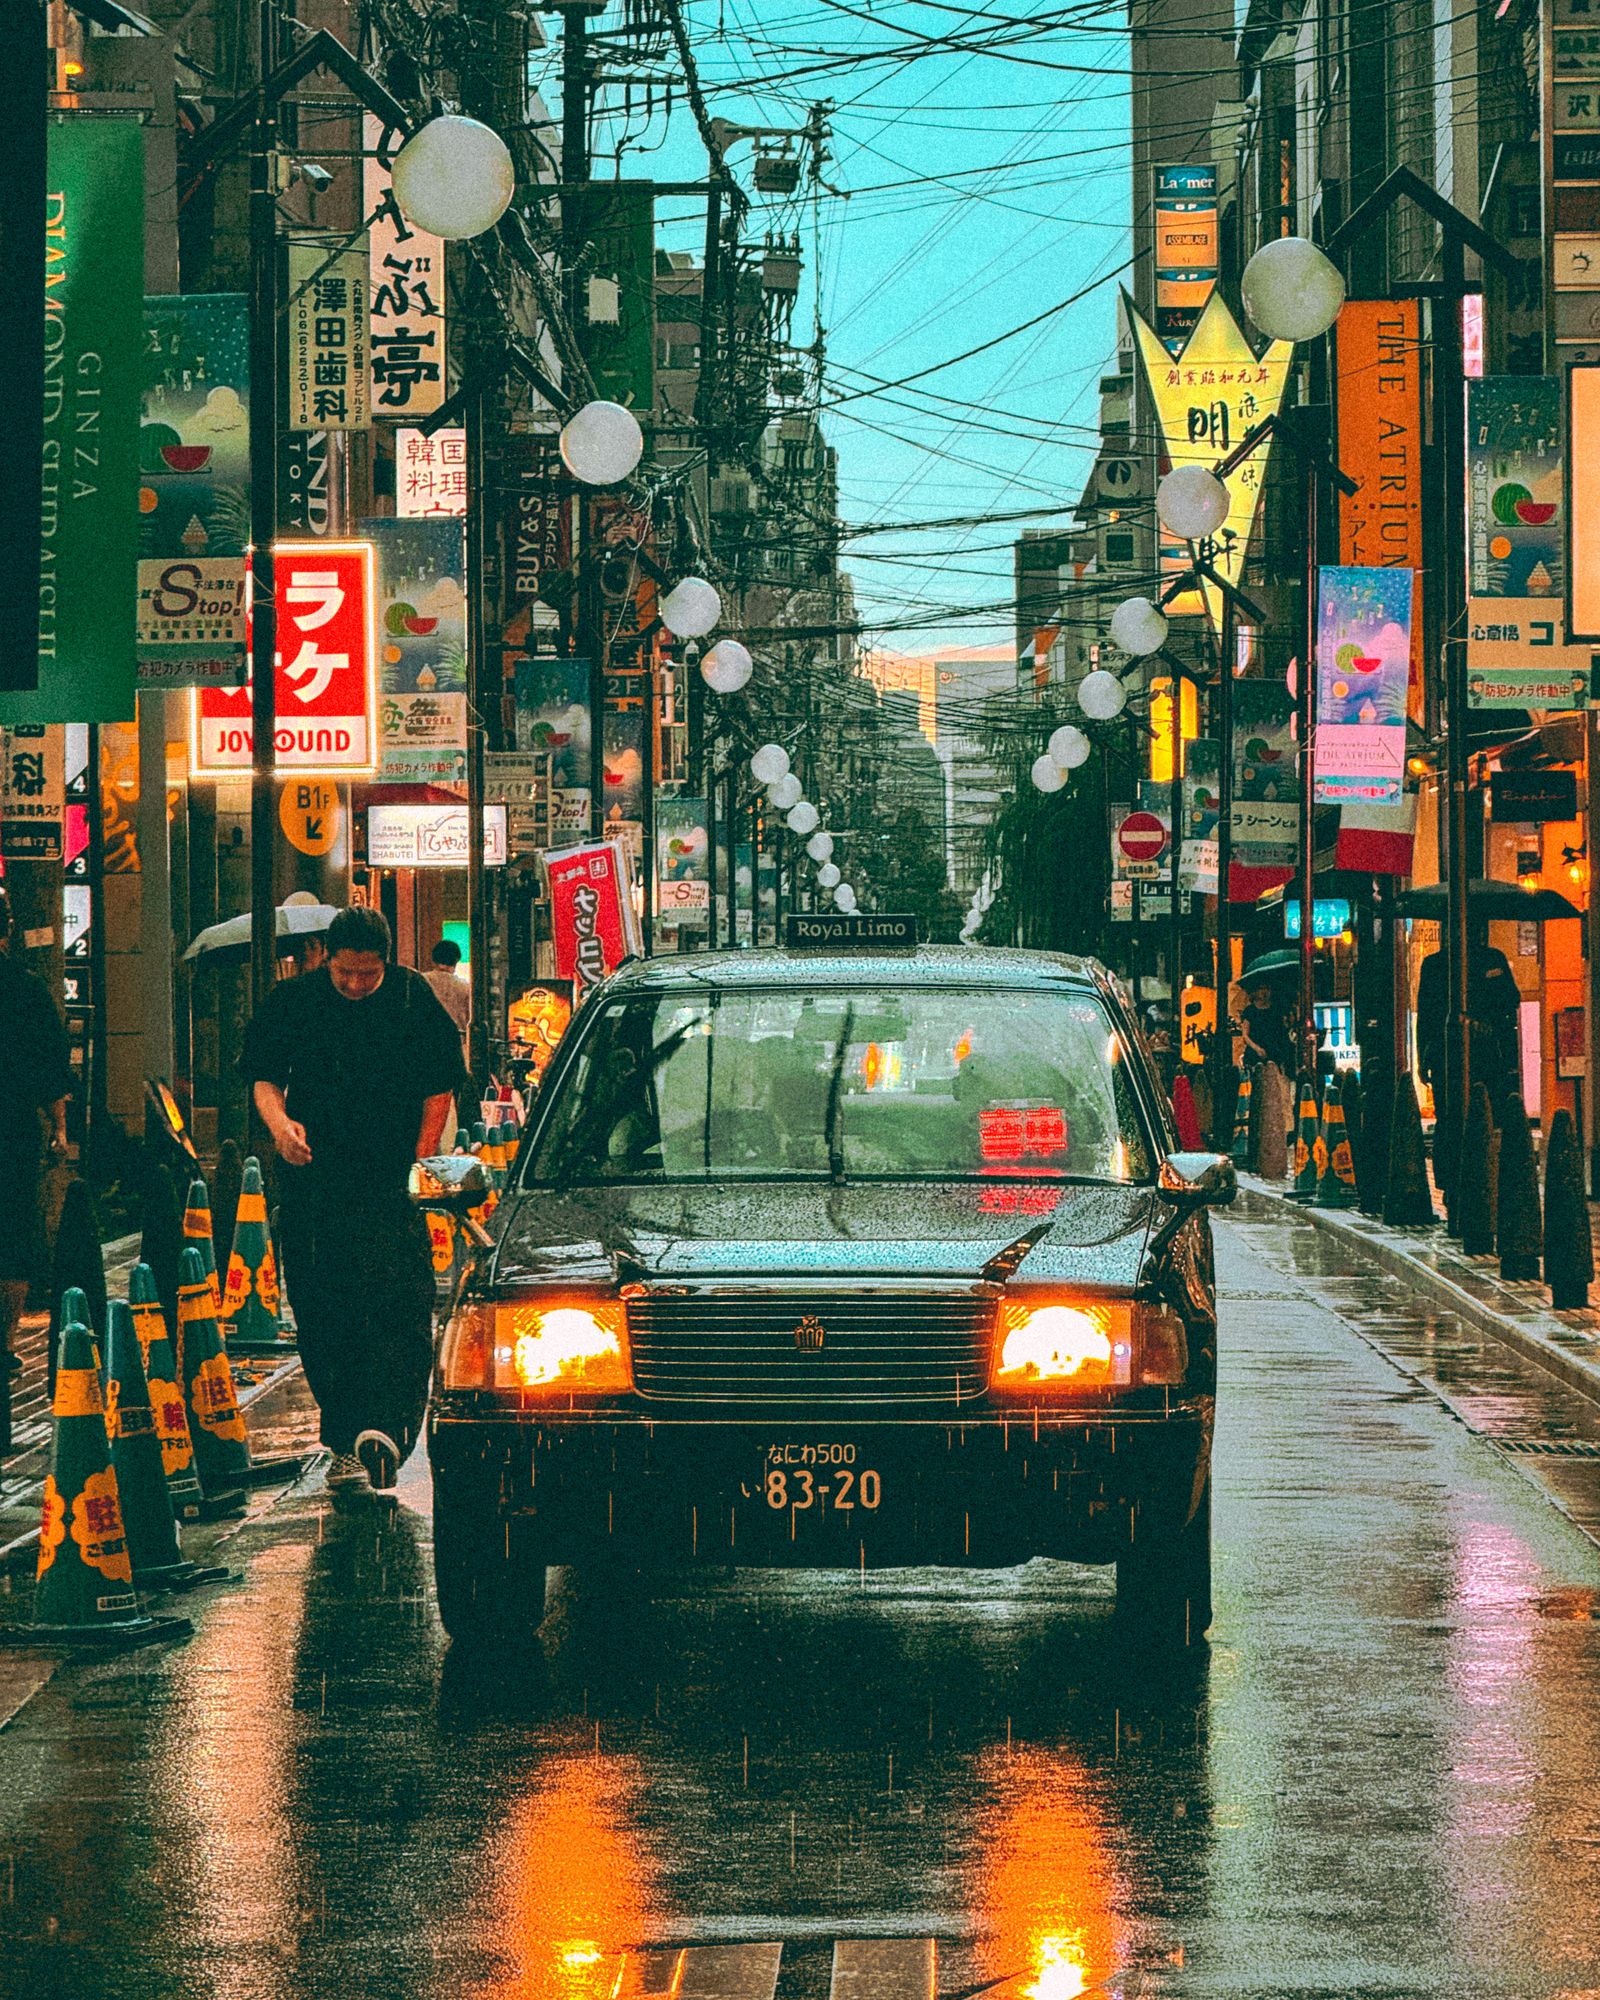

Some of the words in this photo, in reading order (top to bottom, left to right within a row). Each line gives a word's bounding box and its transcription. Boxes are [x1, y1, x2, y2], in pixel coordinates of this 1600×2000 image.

[297, 279, 309, 424] TL06(6252)0118
[313, 278, 348, 424] 澤田歯科
[1378, 312, 1406, 394] THE
[73, 352, 102, 500] GINZA
[406, 438, 466, 466] 韓国
[406, 470, 466, 498] 料理
[520, 516, 540, 533] &
[515, 537, 541, 593] BUY
[153, 564, 246, 616] Stop!
[1470, 624, 1520, 642] 心斎橋
[1484, 684, 1571, 698] 防犯カメラ作動中
[217, 729, 351, 753] JOYOUND
[385, 762, 455, 775] 防犯カメラ作動中
[72, 775, 87, 793] 4
[74, 857, 87, 874] 3
[797, 920, 851, 940] Royal
[856, 919, 906, 936] Limo
[75, 939, 88, 956] 2
[768, 1443, 857, 1465] なにわ500
[766, 1469, 882, 1510] 83-20
